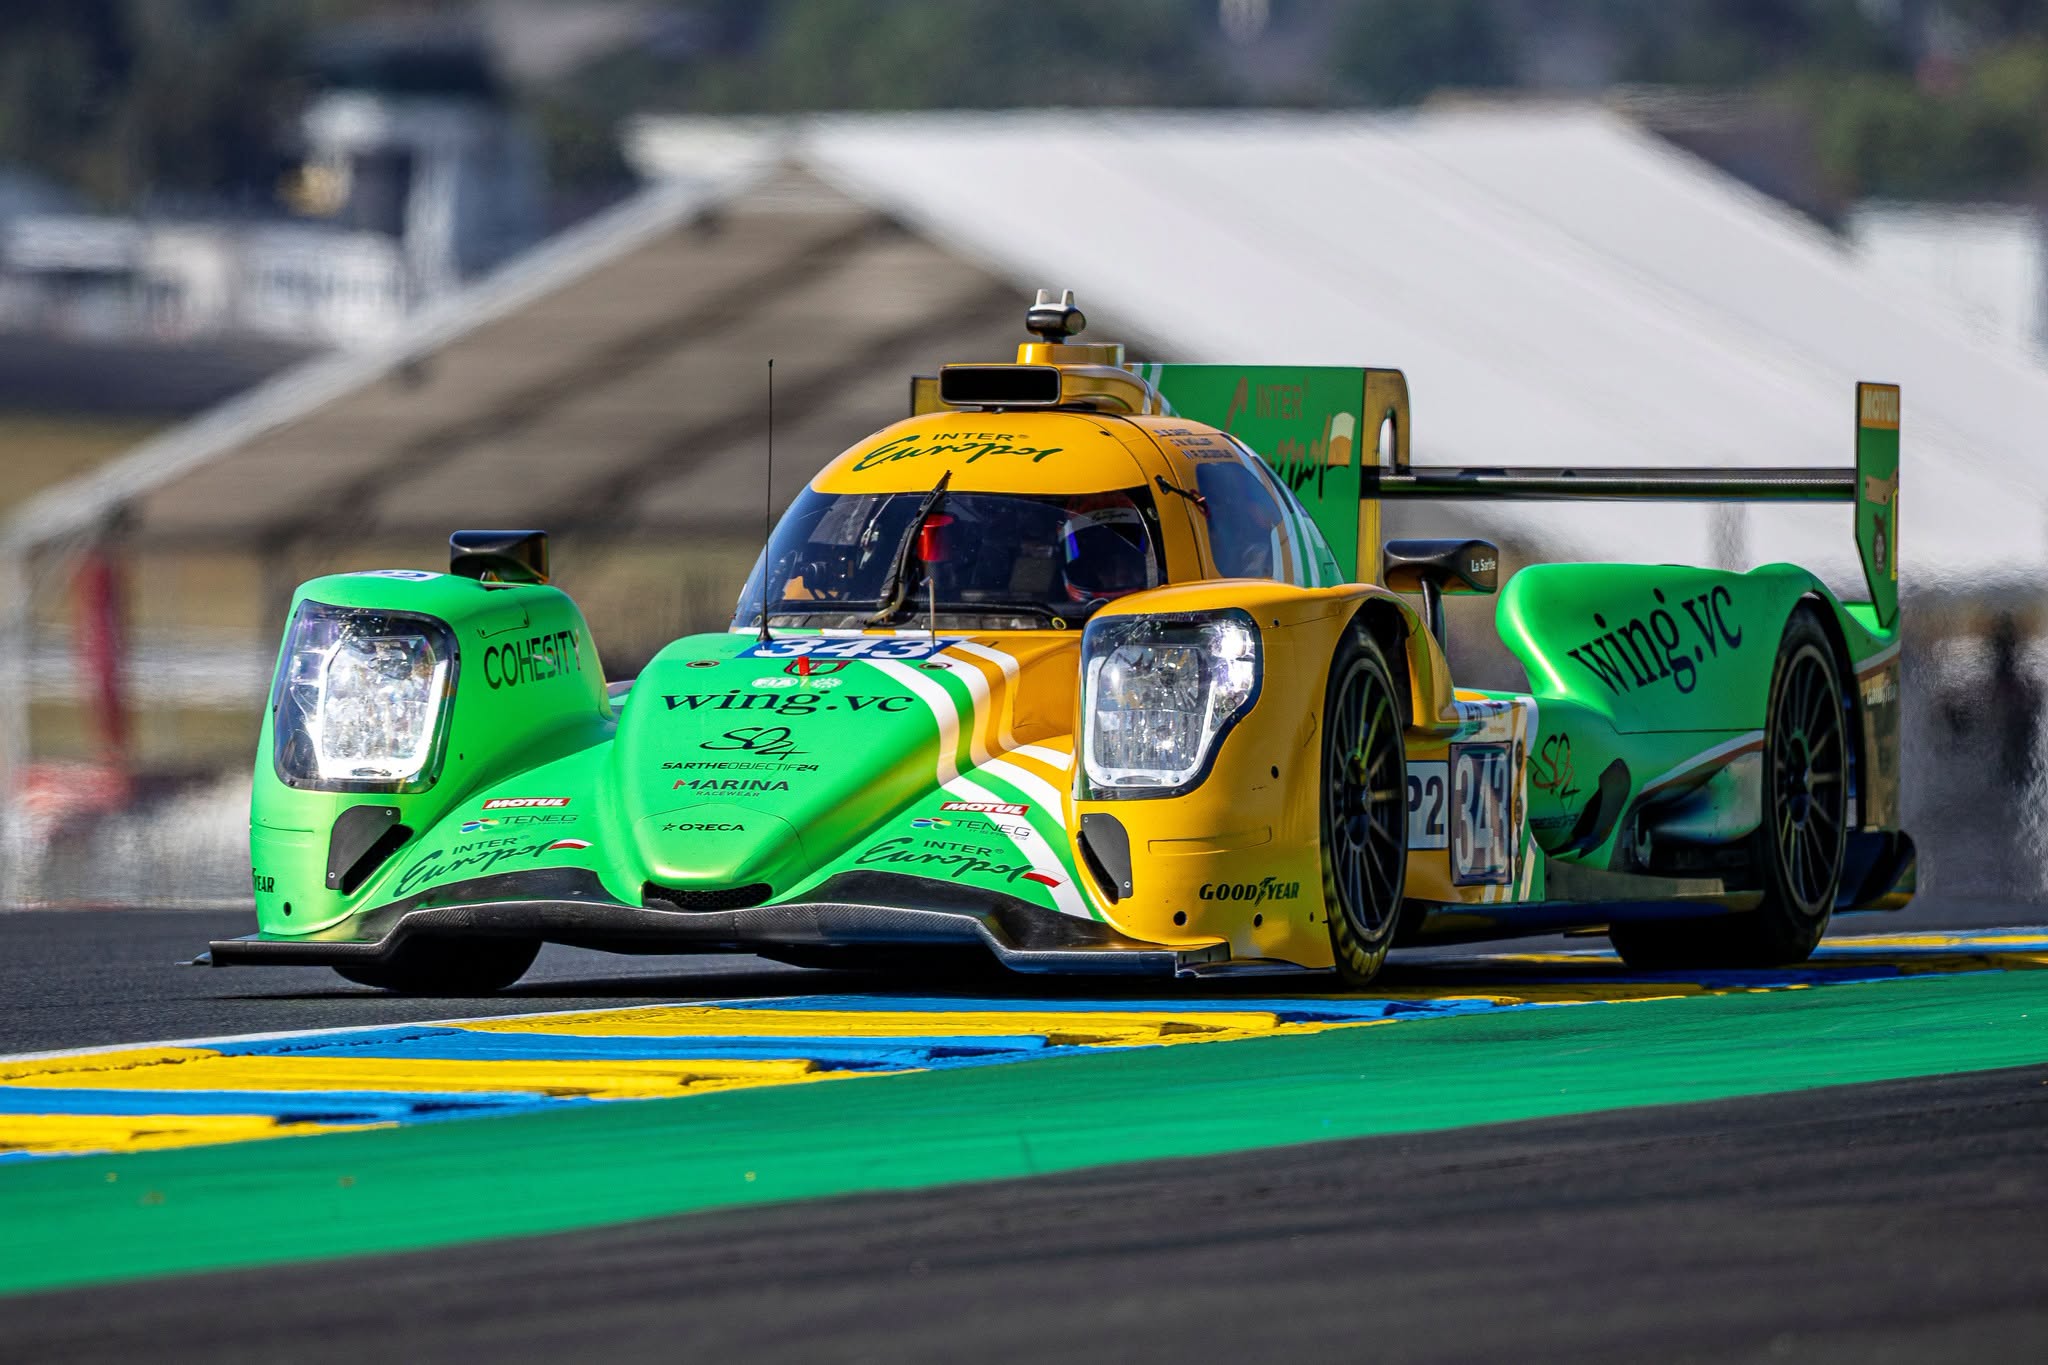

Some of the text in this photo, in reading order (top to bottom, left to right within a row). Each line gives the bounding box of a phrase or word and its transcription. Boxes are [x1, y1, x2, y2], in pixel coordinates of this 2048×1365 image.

[852, 435, 1063, 471] Europol
[753, 639, 935, 658] 343
[1567, 585, 1742, 694] wing.vc
[483, 629, 580, 690] COHESITY
[661, 690, 914, 715] wing.vc
[673, 779, 790, 791] MARINA
[485, 798, 565, 809] MOTUL
[943, 803, 1025, 815] MOTUL
[502, 814, 579, 825] TENEG
[679, 823, 745, 832] ORECA
[954, 819, 1032, 838] TENEG
[393, 839, 559, 897] Europol
[855, 837, 1034, 884] Europol
[1199, 879, 1299, 901] GOODYEAR
